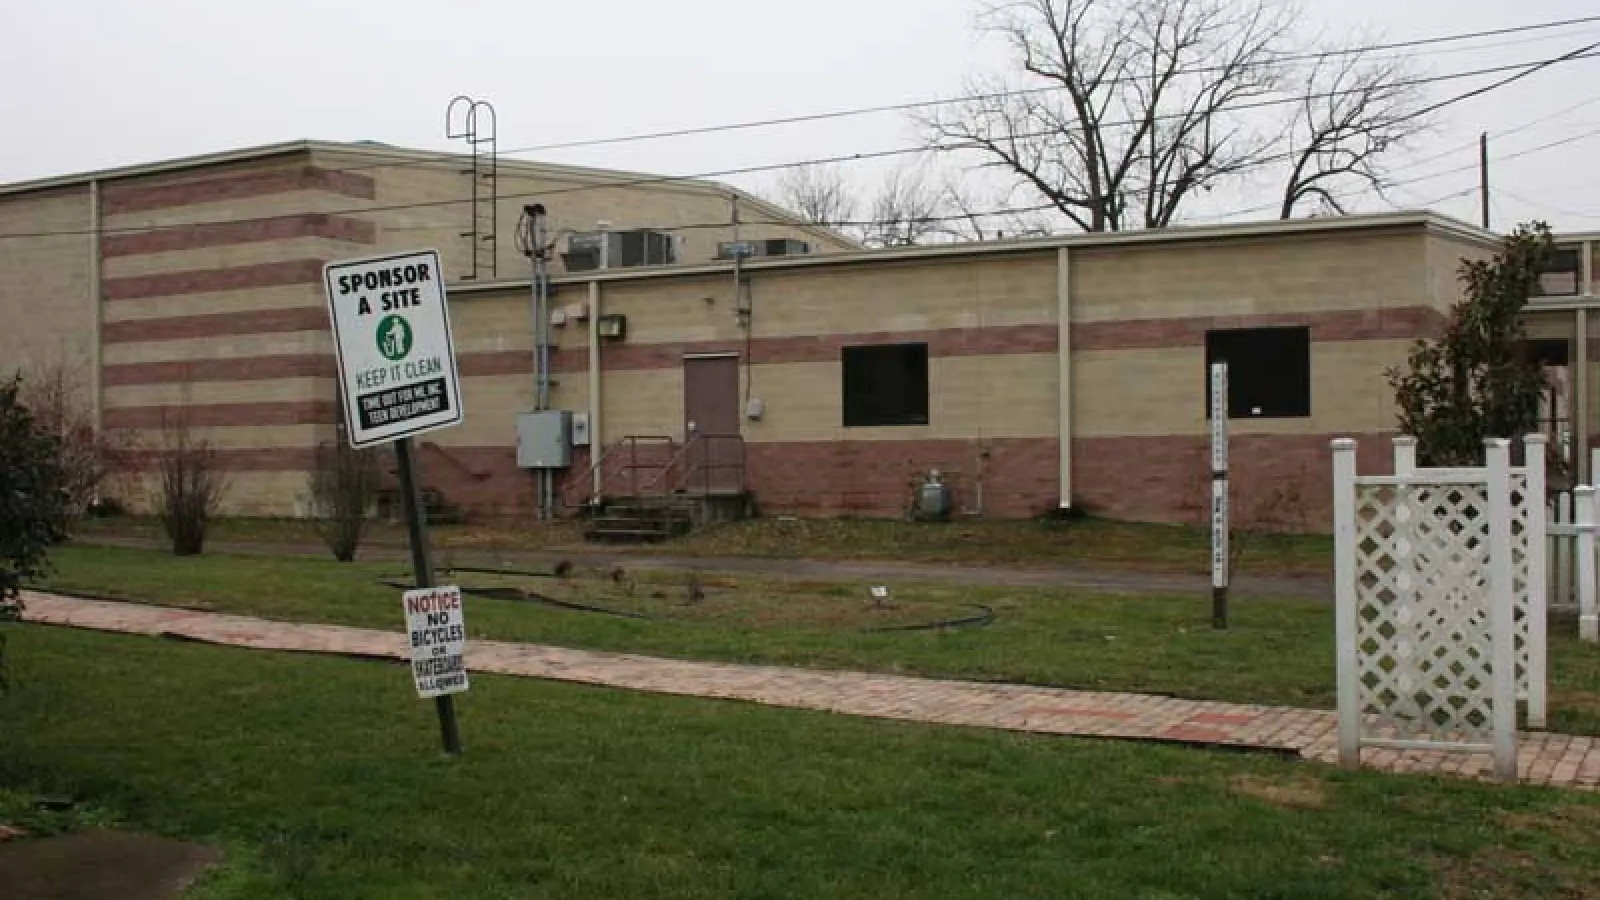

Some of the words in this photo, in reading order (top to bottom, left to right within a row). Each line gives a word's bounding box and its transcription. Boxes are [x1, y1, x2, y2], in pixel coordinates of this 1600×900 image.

[338, 263, 430, 294] SPONSOR
[358, 296, 372, 314] A
[382, 288, 422, 310] SITE
[356, 368, 387, 390] KEEP
[390, 365, 401, 381] IT
[405, 356, 443, 378] CLEAN
[408, 592, 459, 614] NOTICE
[427, 611, 448, 626] NO
[412, 624, 463, 647] BICYCLES
